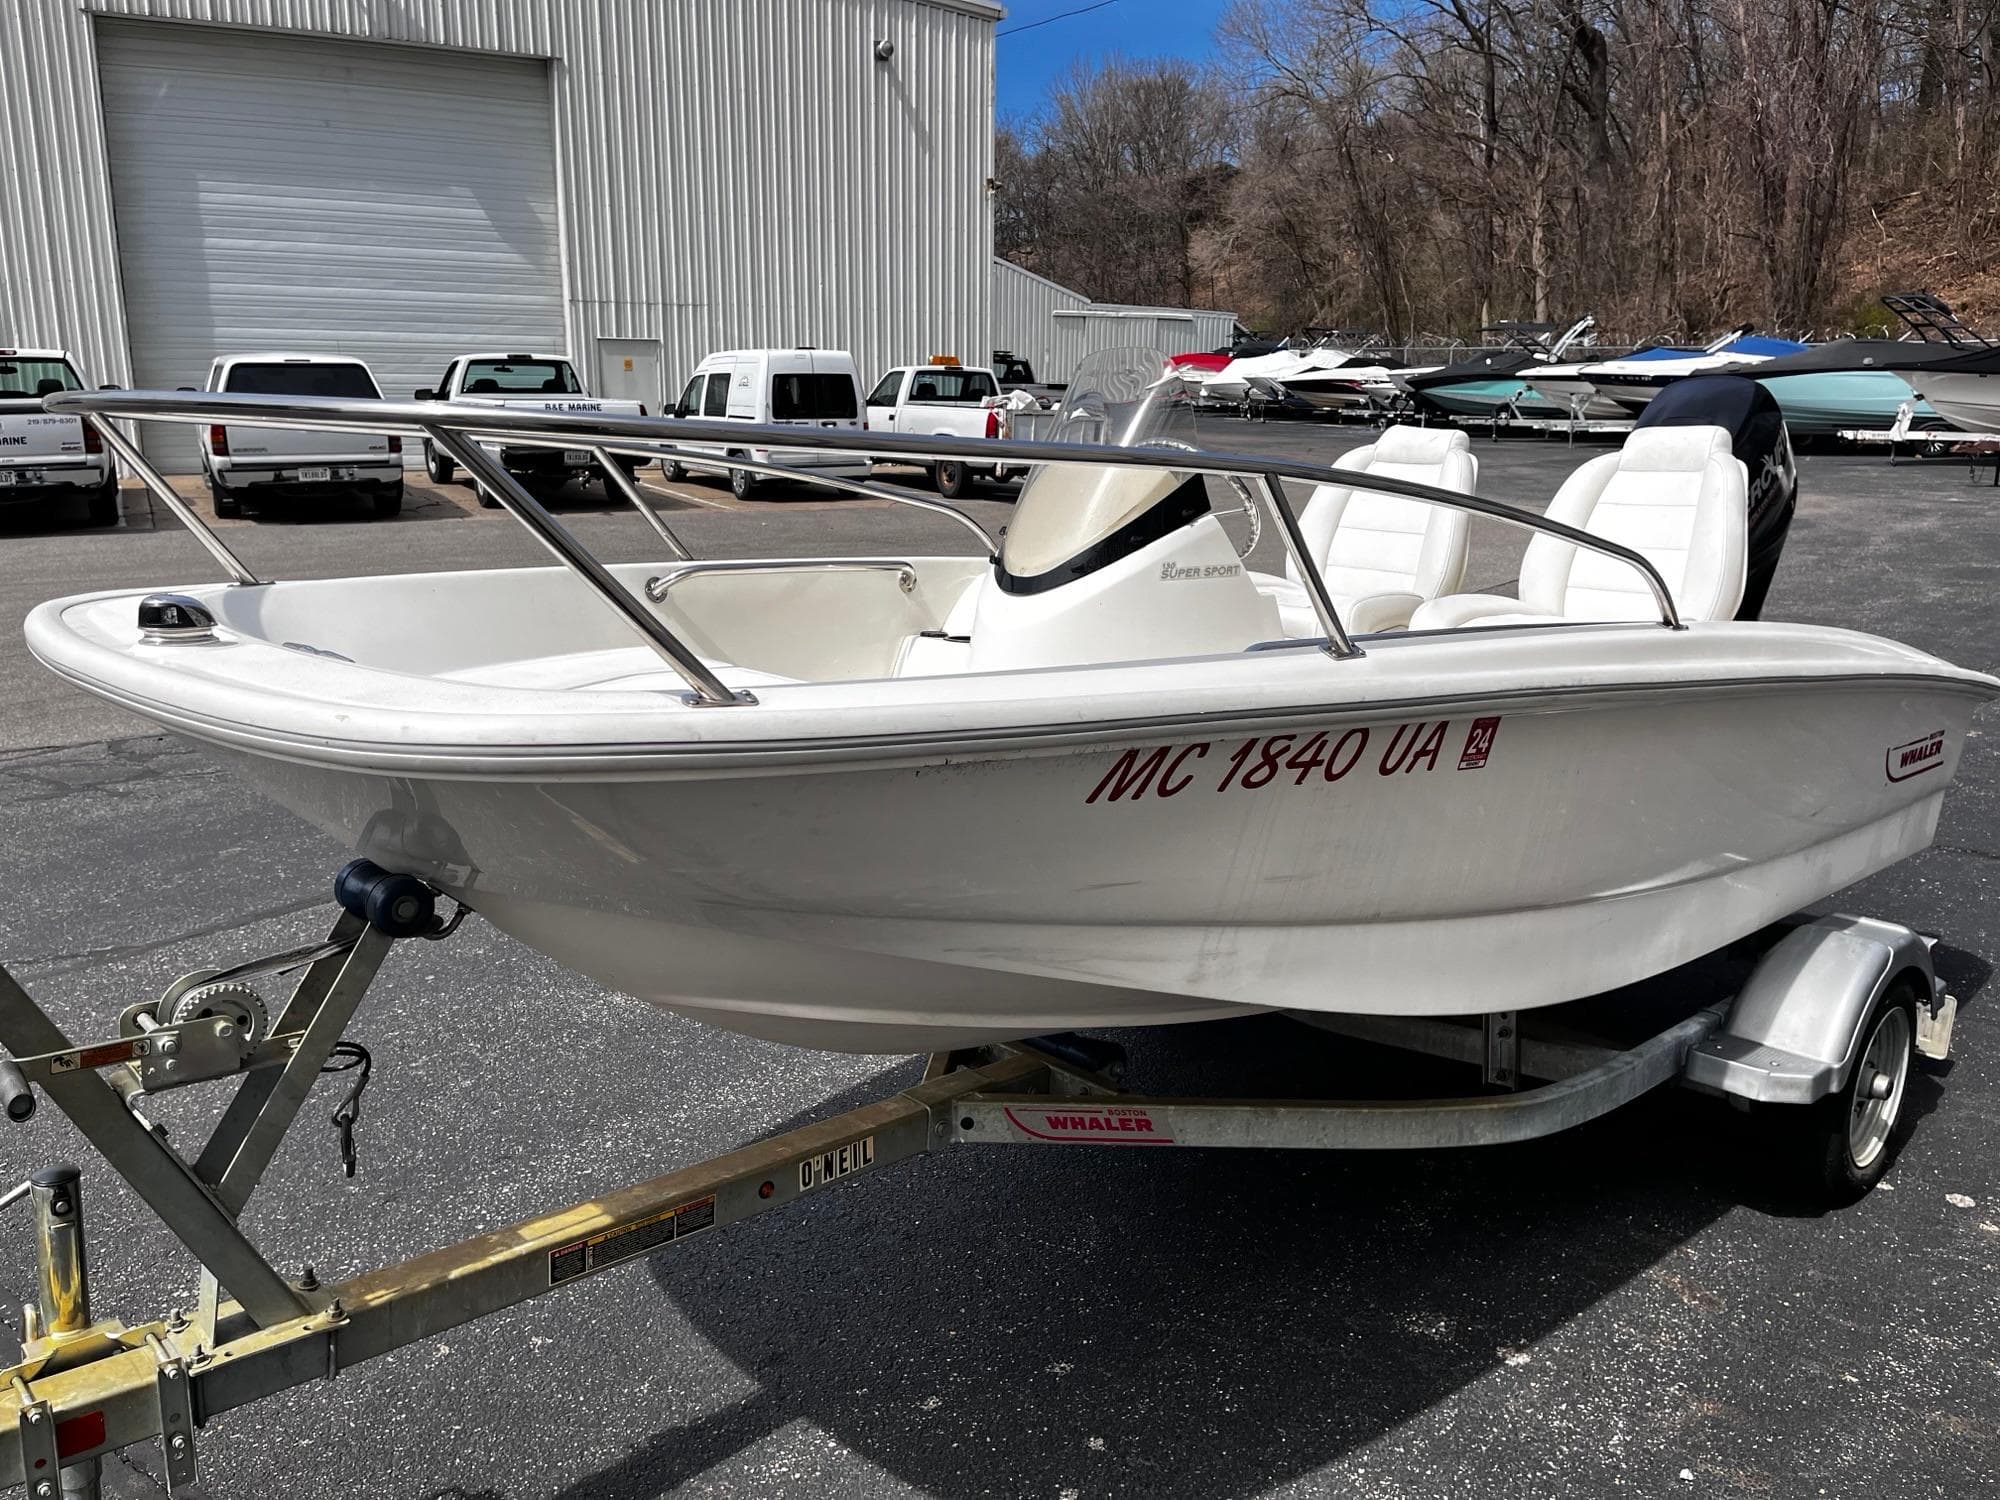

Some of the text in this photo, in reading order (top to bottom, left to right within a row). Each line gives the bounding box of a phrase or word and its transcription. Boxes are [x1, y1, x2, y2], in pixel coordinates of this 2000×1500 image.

[568, 403, 602, 412] MARINE
[1160, 565, 1240, 579] SUPER SPORT
[1466, 727, 1493, 754] 24
[1085, 720, 1450, 804] MC 1840 UA
[1900, 739, 1943, 769] WHALER
[1045, 1115, 1154, 1132] WHALER
[1107, 1109, 1147, 1117] BOSTON
[800, 1136, 874, 1192] O'NEIL
